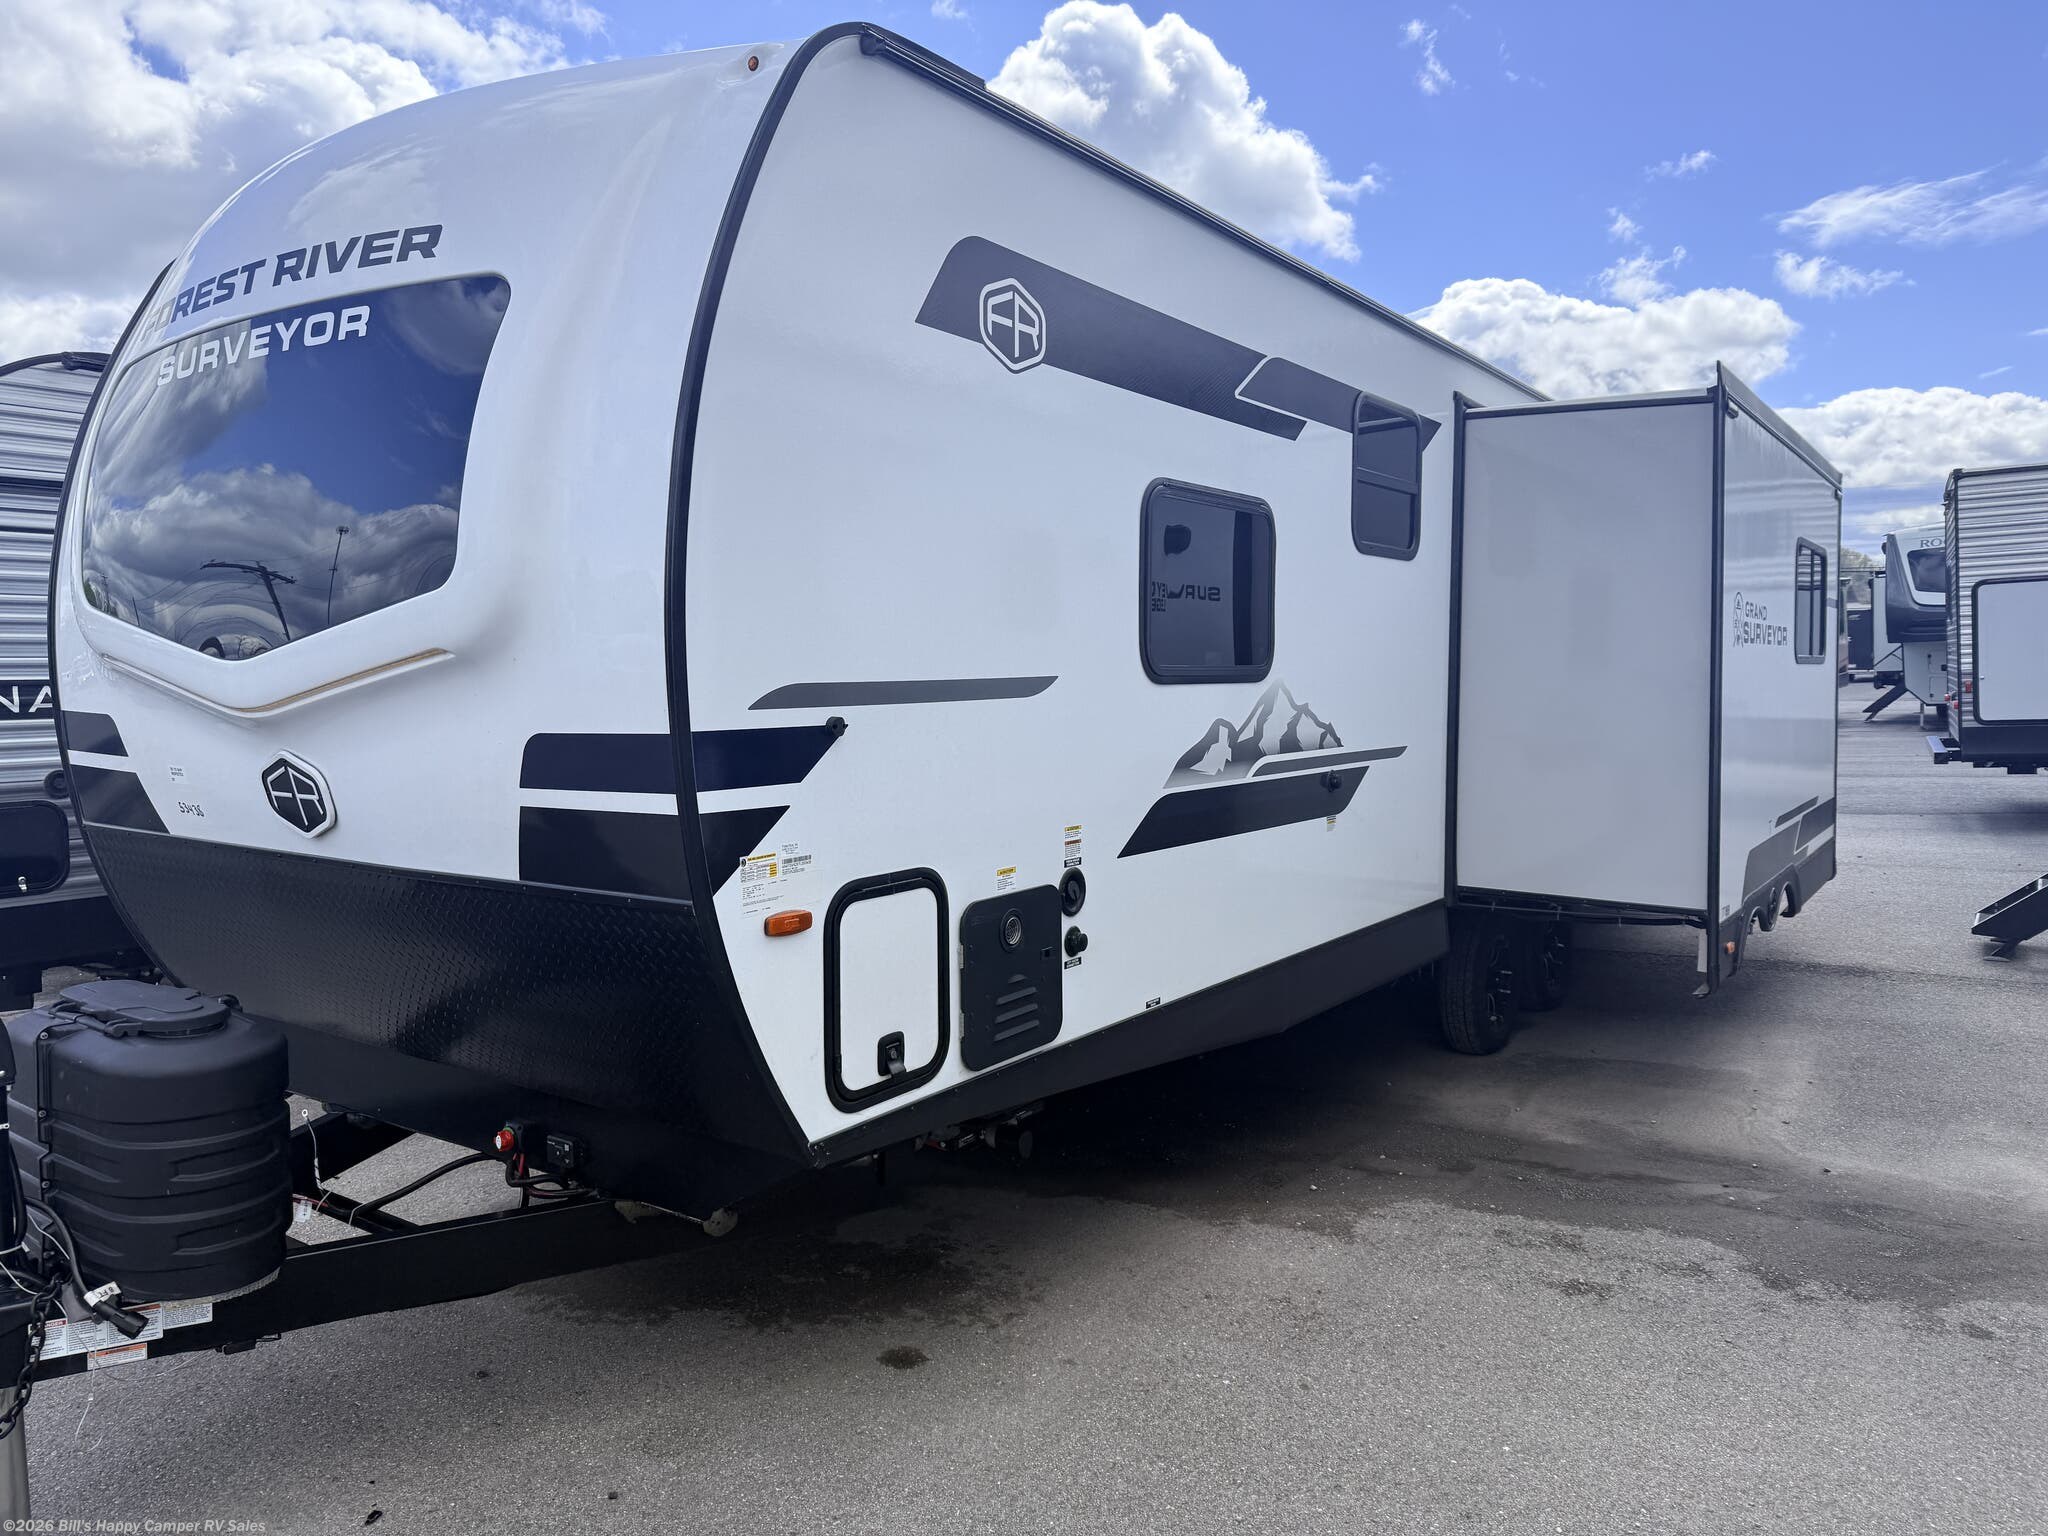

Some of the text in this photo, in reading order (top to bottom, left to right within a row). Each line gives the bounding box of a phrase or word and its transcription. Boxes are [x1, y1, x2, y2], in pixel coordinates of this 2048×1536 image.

[272, 224, 443, 287] RIVER
[156, 304, 371, 387] SURVEYOR
[1920, 537, 1946, 549] RO
[1745, 601, 1768, 621] GRAND
[1743, 621, 1788, 646] SURVEYOR
